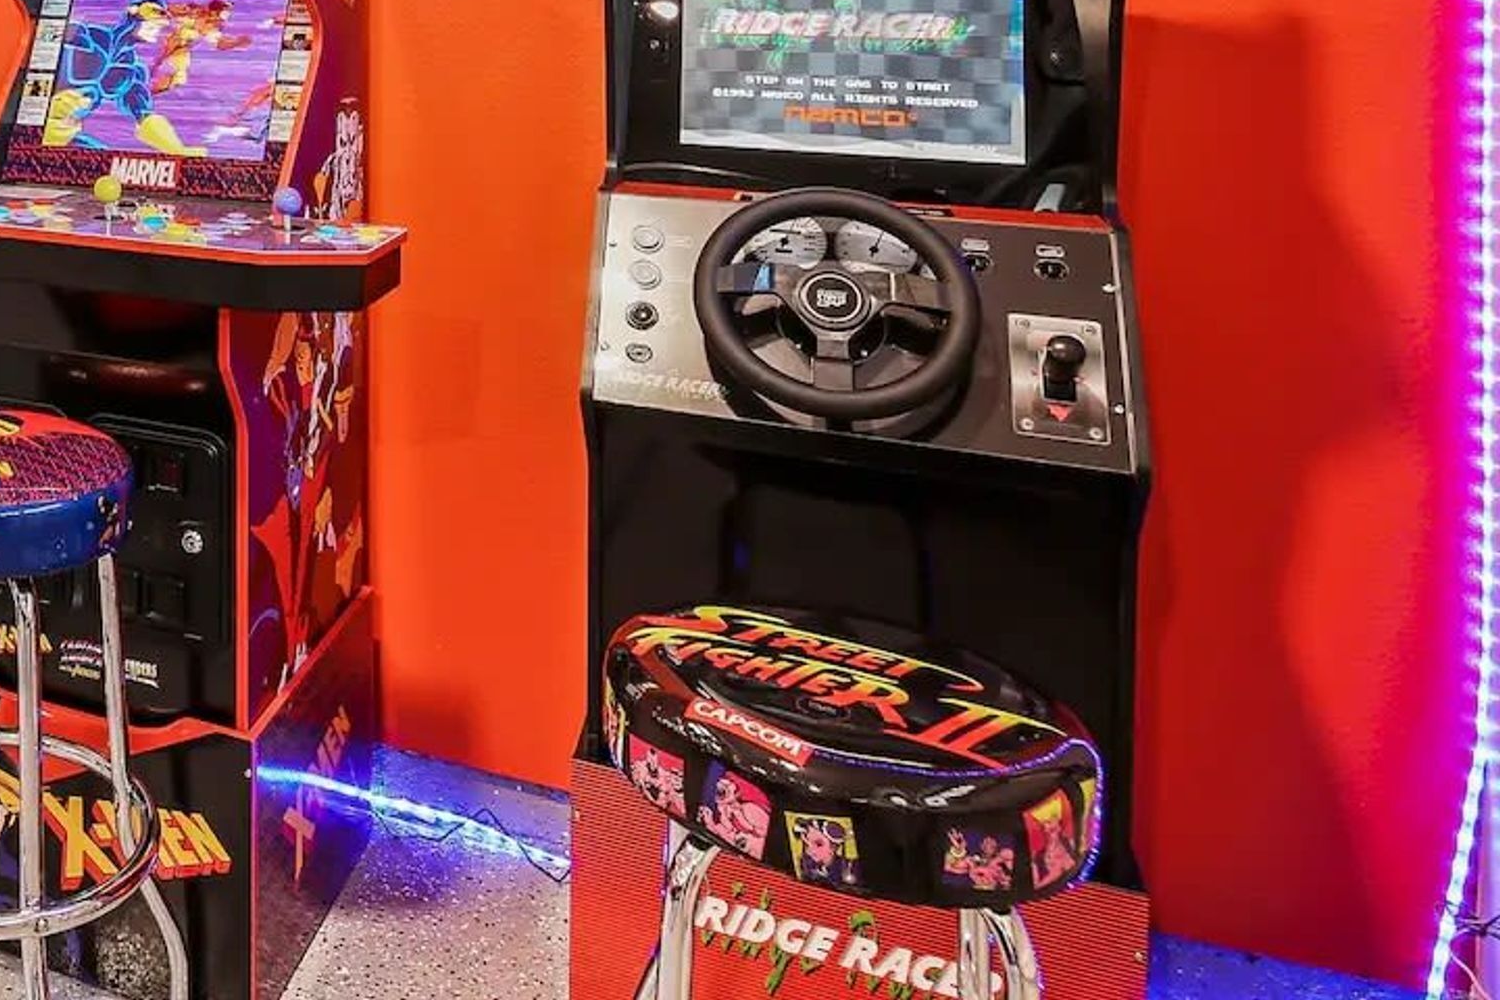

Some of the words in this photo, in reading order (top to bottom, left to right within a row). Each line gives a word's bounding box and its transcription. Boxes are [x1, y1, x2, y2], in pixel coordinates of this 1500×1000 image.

[745, 75, 779, 85] STEP
[813, 78, 837, 88] THE
[881, 81, 899, 90] TO
[810, 91, 837, 102] ALL
[844, 94, 898, 105] RIGHTS
[904, 96, 979, 109] RESERVED
[110, 156, 177, 188] MARVEL
[626, 625, 912, 729] FIGHTER
[640, 605, 986, 693] STREET
[693, 700, 804, 757] CAPCOM
[694, 895, 840, 961] RIDGE
